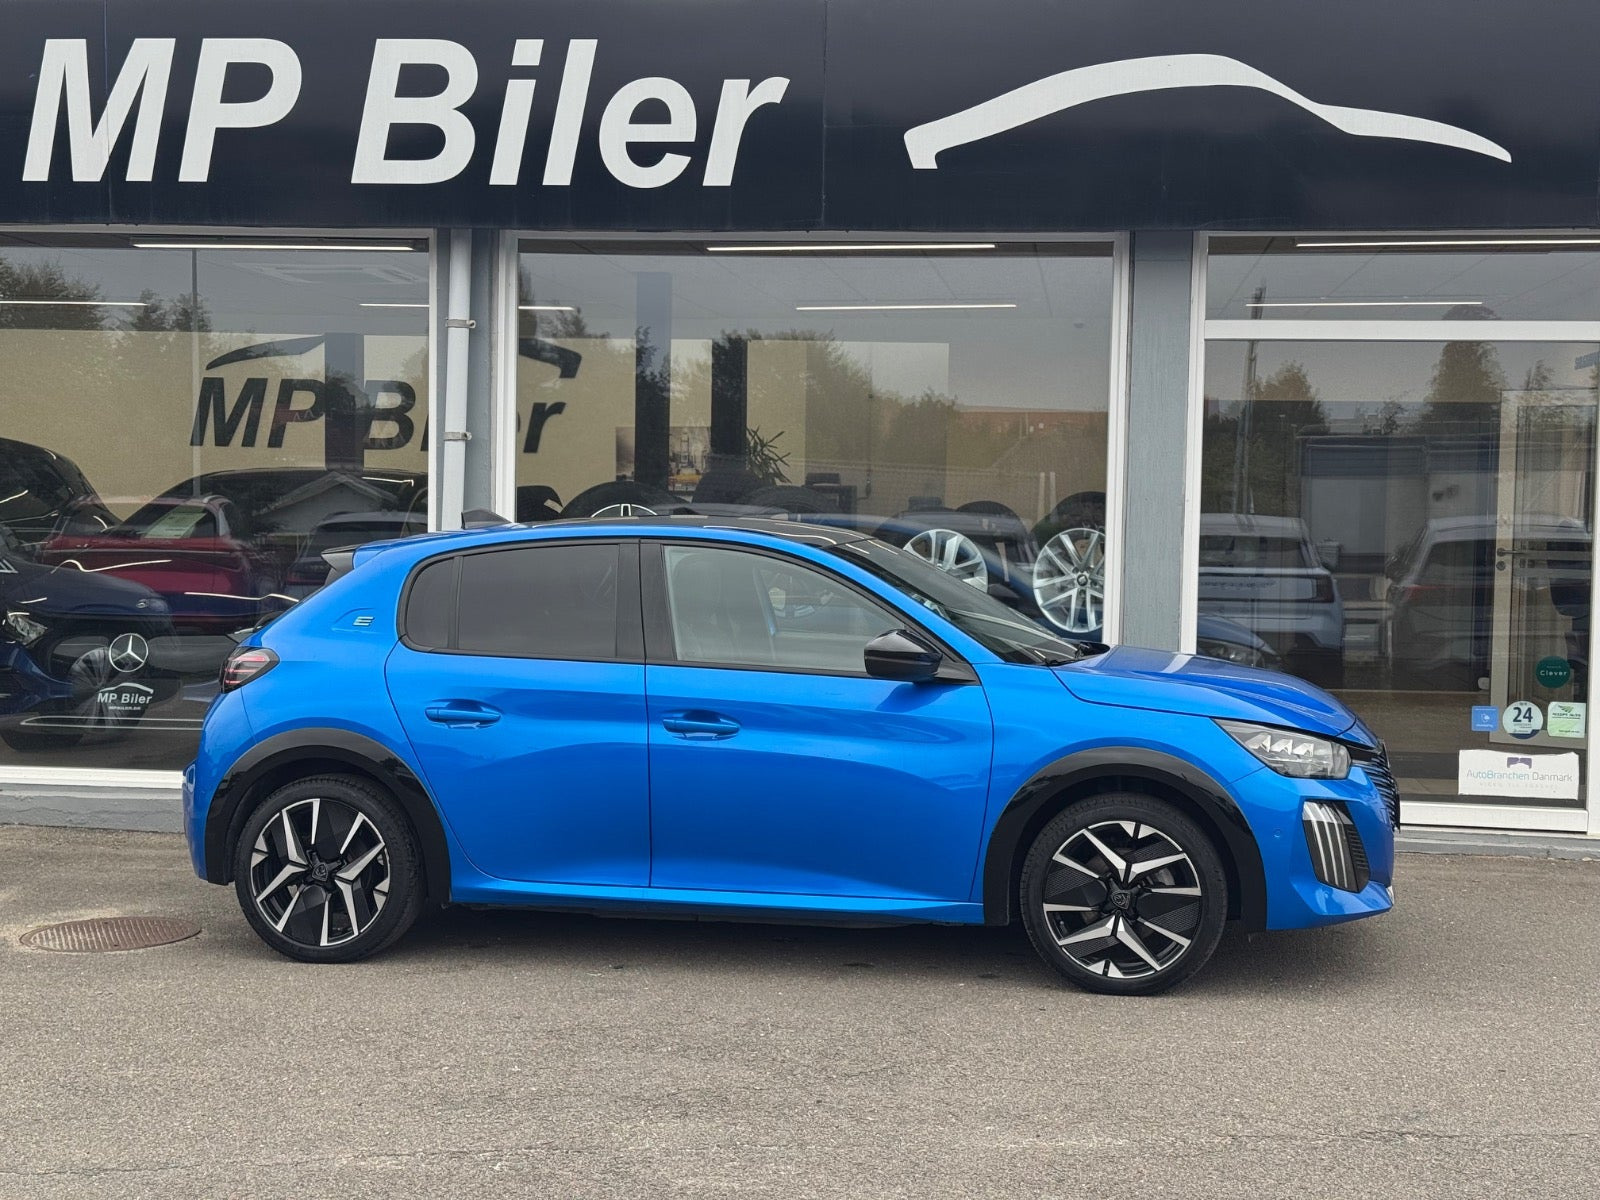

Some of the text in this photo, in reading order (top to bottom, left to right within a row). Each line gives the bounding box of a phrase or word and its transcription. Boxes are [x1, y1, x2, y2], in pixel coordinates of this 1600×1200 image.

[22, 38, 791, 189] MP Biler
[97, 692, 153, 704] MP Biler
[1512, 706, 1534, 723] 24
[1466, 769, 1573, 782] AutoBranchen Danmark
